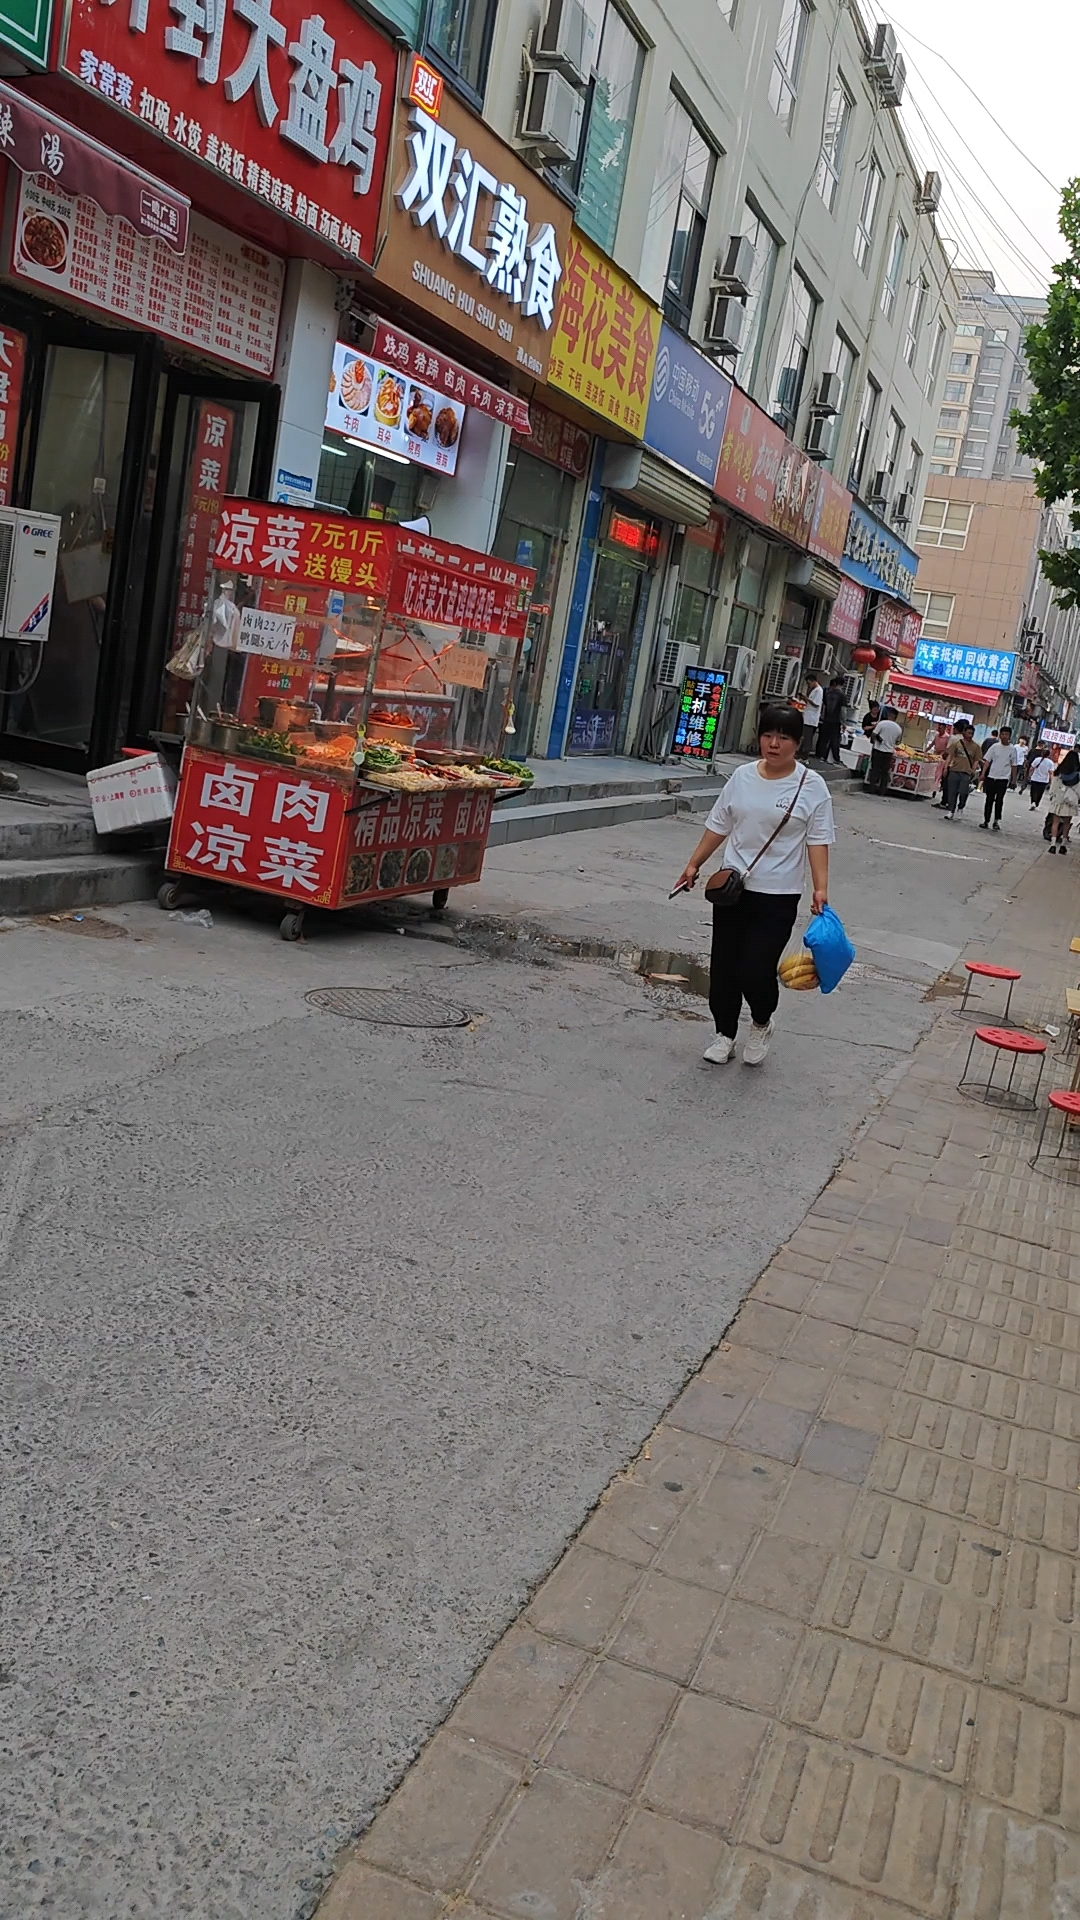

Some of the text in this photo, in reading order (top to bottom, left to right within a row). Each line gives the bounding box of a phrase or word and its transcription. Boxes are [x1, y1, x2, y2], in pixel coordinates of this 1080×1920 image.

[104, 0, 383, 195] 到大盘鸡
[414, 67, 438, 98] 双汇
[79, 48, 361, 257] 家常菜 扣碗 水饺 盖浇饭 精美凉菜 烩面 汤面 炒面
[142, 199, 178, 227] 一鸣广告
[394, 107, 562, 331] 双汇熟食
[412, 260, 513, 344] SHUANG HUI SHU SHI
[557, 236, 654, 406] 海花美食
[383, 334, 409, 365] 烧鸡
[414, 351, 439, 381] 猪蹄
[444, 367, 467, 397] 卤肉
[470, 383, 492, 411] 牛肉
[495, 396, 515, 423] 凉菜
[568, 368, 583, 392] 干锅
[585, 379, 606, 408] 盖浇饭
[608, 393, 621, 417] 面食
[671, 360, 701, 404] 中国移动
[343, 415, 359, 433] 牛肉
[667, 385, 696, 422] China Mobile
[198, 413, 228, 493] 凉菜
[377, 427, 391, 445] 耳朵
[408, 439, 421, 458] 烧鸡
[31, 527, 54, 539] GREE
[215, 508, 385, 575] 凉菜 7元1斤
[303, 552, 378, 590] 送馒头
[918, 643, 963, 665] 汽车抵押
[965, 651, 1011, 672] 回收黄金
[681, 696, 693, 713] 回收
[686, 682, 712, 747] 手机维修
[884, 691, 934, 713] 大锅卤肉
[199, 762, 331, 834] 卤肉
[354, 790, 491, 848] 精品凉菜 卤肉
[184, 819, 324, 893] 凉菜
